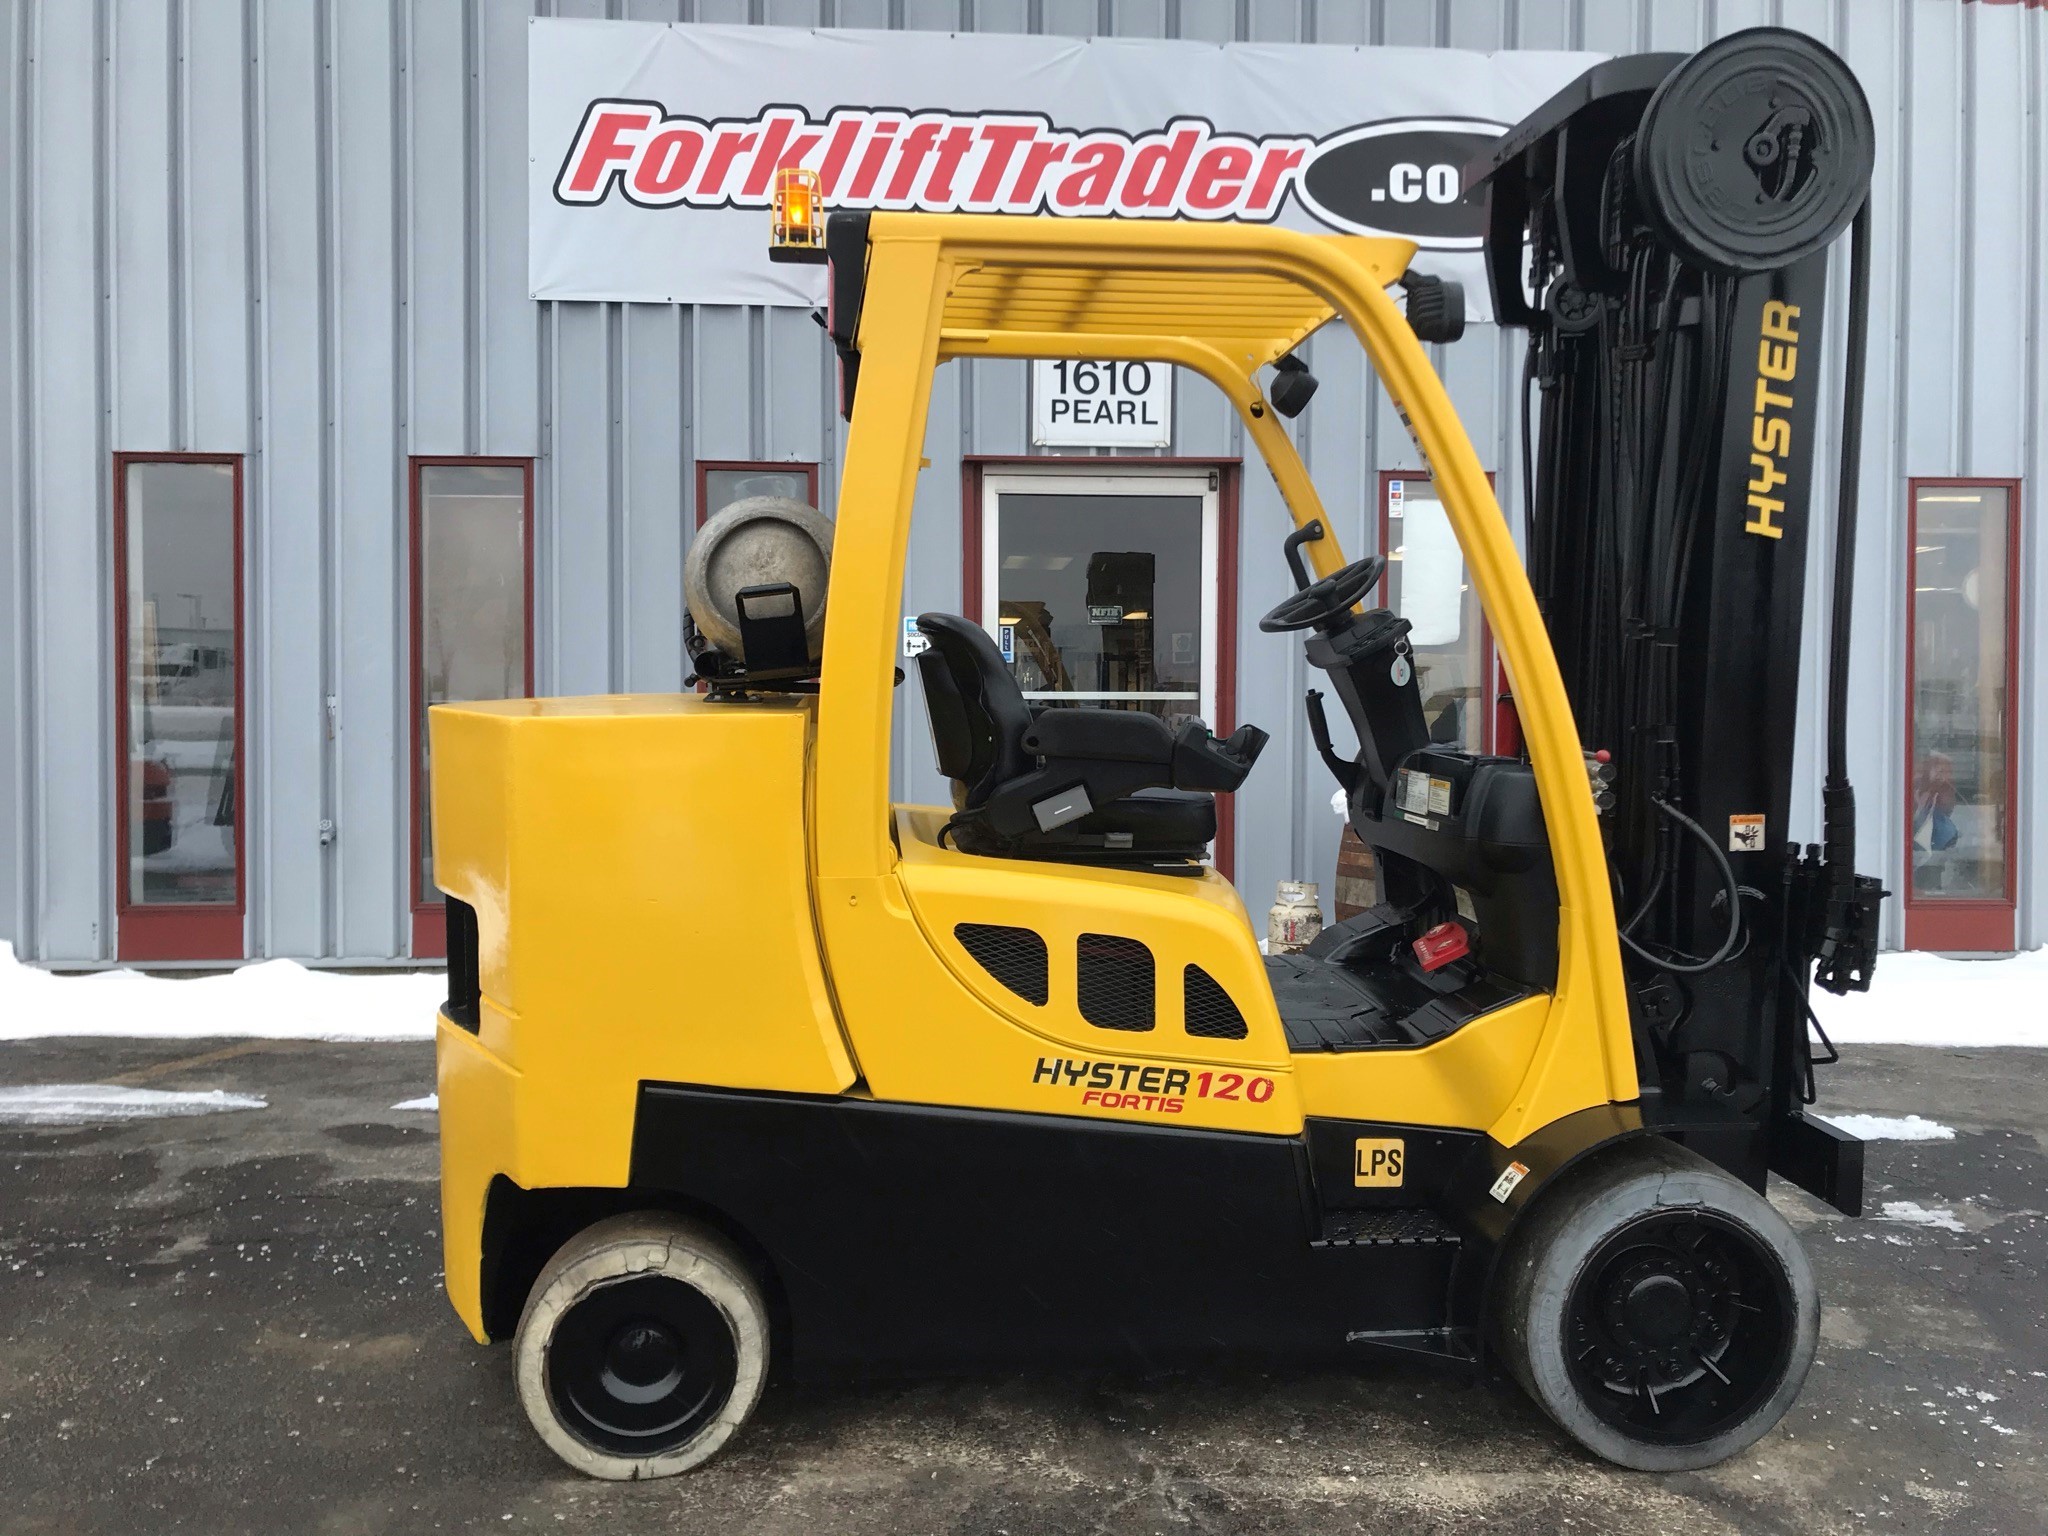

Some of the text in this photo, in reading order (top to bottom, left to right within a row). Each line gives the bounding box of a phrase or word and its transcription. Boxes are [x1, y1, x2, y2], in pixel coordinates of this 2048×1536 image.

[569, 112, 1306, 210] ForkliftTrader
[1053, 361, 1151, 395] 1610
[1051, 399, 1158, 425] PEARL
[1746, 300, 1801, 538] HYSTER
[1032, 1056, 1275, 1104] HYSTER 120
[1081, 1090, 1184, 1114] FORTIS
[1355, 1148, 1403, 1178] LPS
